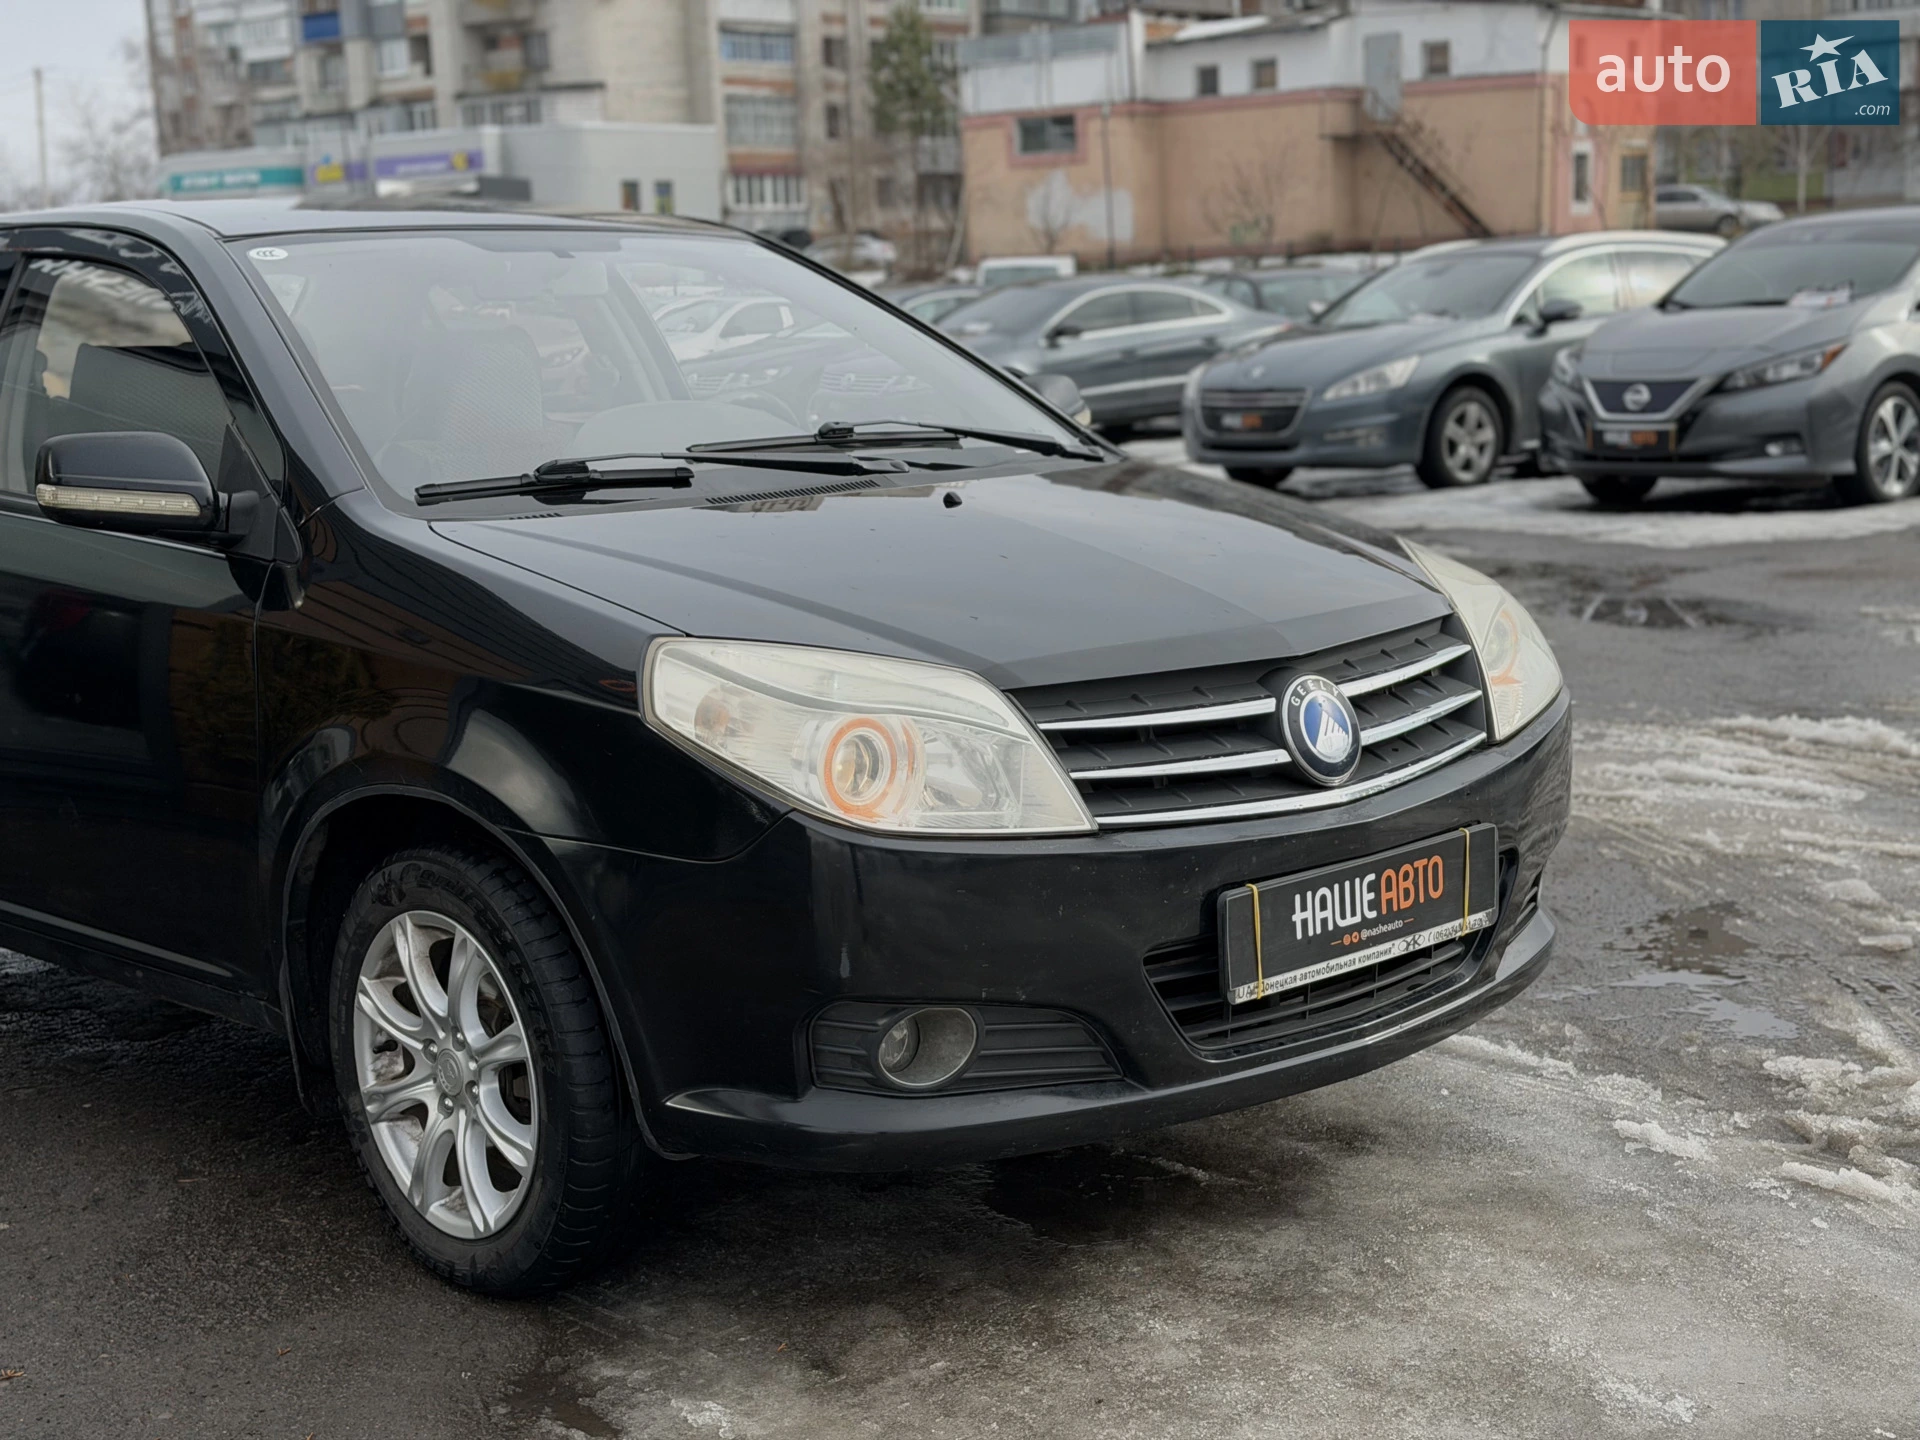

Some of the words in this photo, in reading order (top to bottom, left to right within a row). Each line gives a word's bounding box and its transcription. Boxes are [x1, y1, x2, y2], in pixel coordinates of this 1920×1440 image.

[1291, 680, 1339, 707] GEELY
[1292, 873, 1378, 940] НАШЕ
[1380, 855, 1444, 915] АВТО
[1360, 919, 1404, 940] @nasheauto
[1299, 957, 1356, 982] автомобильная
